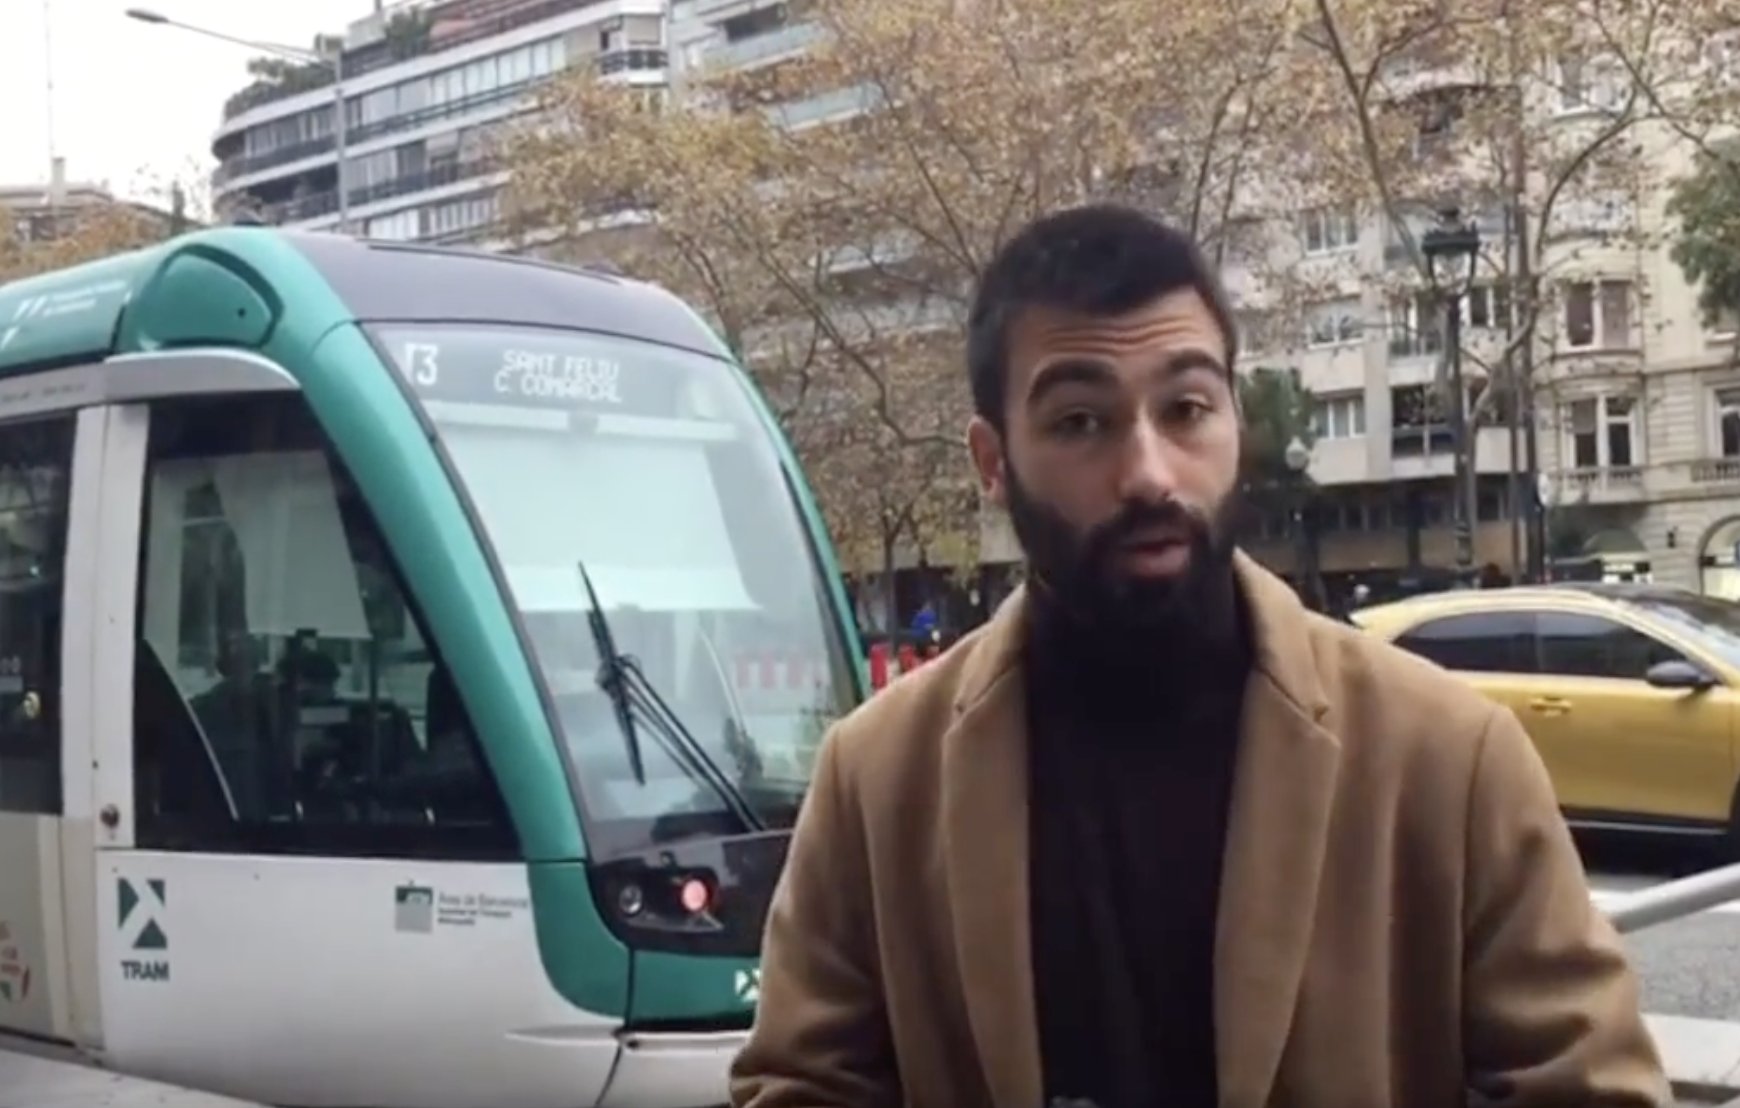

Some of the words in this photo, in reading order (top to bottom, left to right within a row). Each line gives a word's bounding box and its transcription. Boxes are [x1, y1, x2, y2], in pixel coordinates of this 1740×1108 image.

[503, 349, 556, 374] SANT
[564, 356, 620, 381] FELIU
[520, 373, 623, 403] COMARCAL
[120, 960, 170, 981] TRAM
